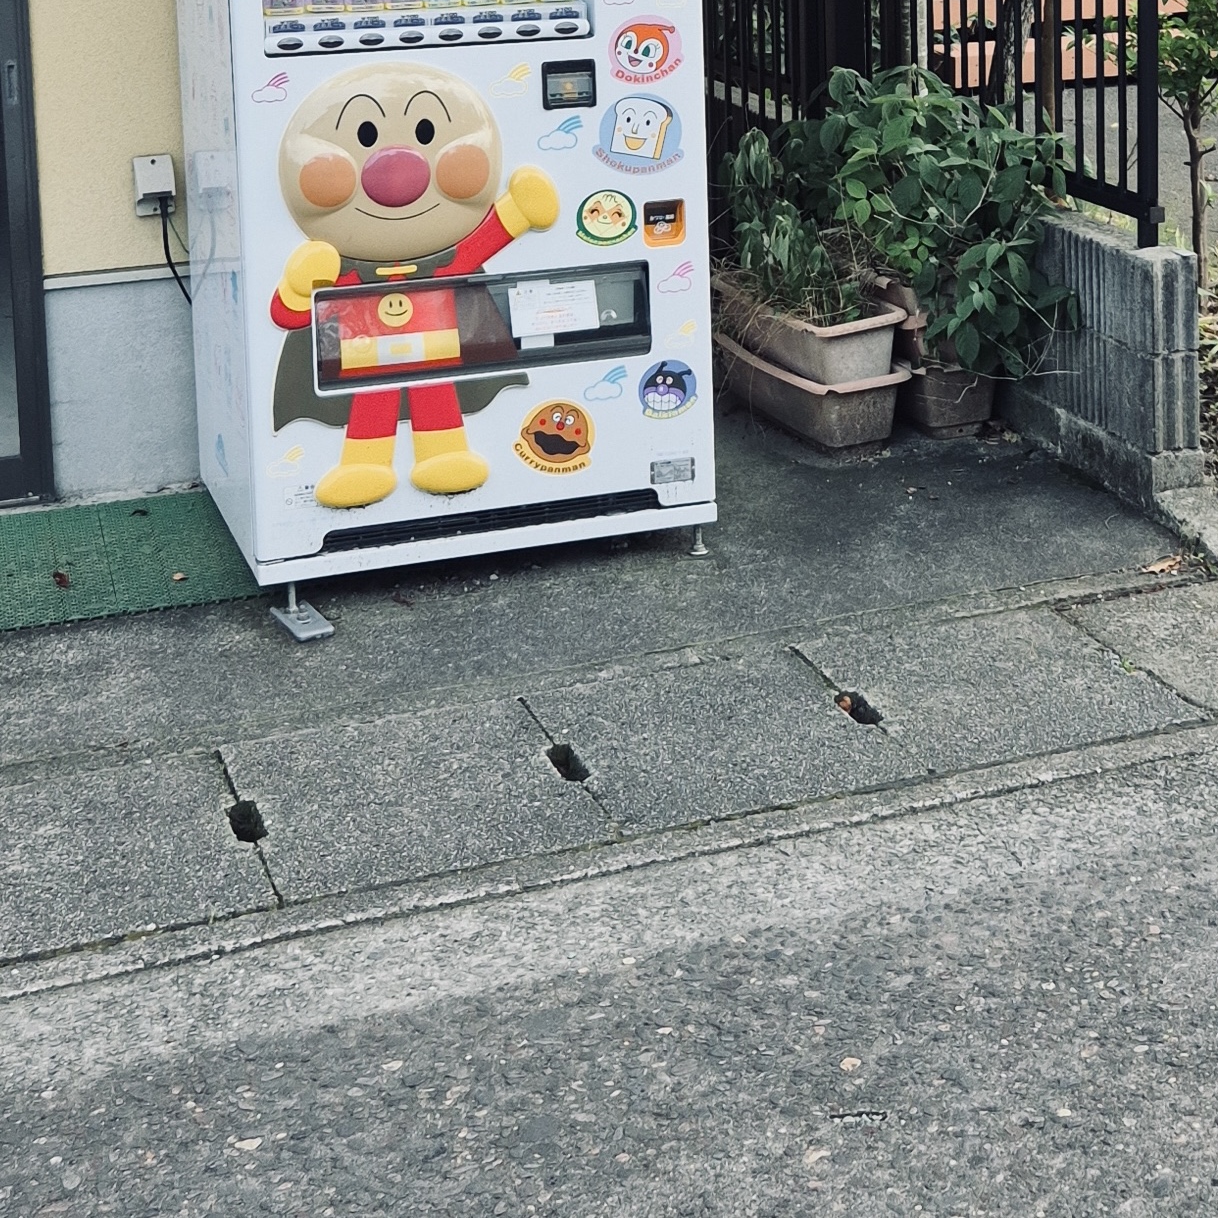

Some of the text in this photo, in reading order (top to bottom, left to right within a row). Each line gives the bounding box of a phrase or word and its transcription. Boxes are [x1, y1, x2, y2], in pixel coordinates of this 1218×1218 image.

[615, 58, 682, 83] Dokinchan
[595, 147, 681, 174] Shokupanman
[514, 442, 586, 473] Currypanman
